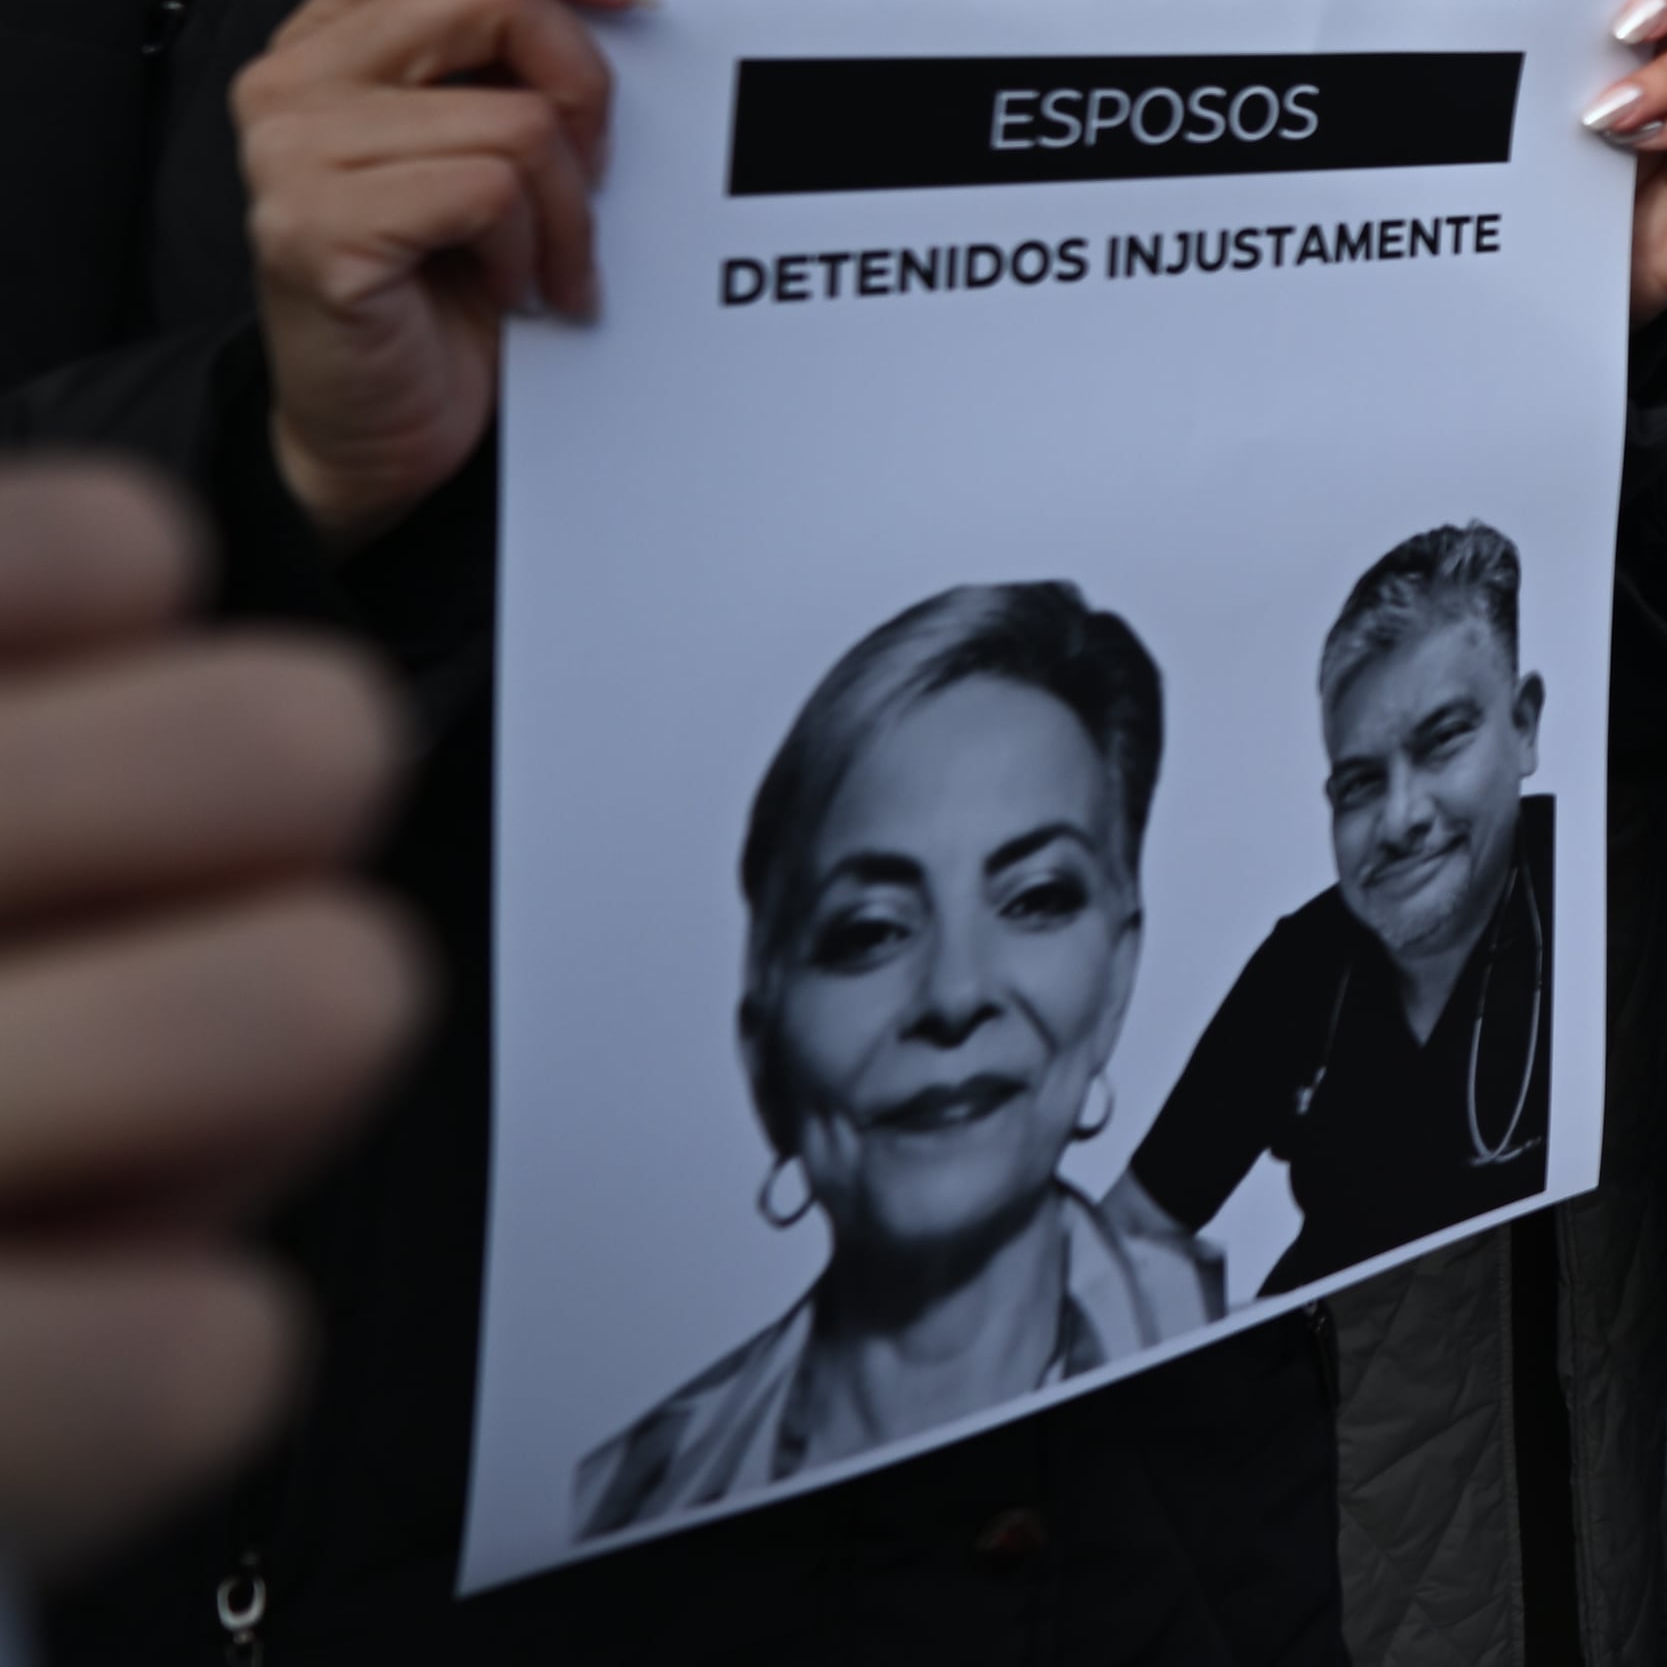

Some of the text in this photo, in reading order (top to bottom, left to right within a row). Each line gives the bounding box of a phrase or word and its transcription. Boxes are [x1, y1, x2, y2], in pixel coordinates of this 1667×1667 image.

[990, 86, 1319, 151] ESPOSOS
[721, 214, 1501, 307] DETENIDOS INJUSTAMENTE
